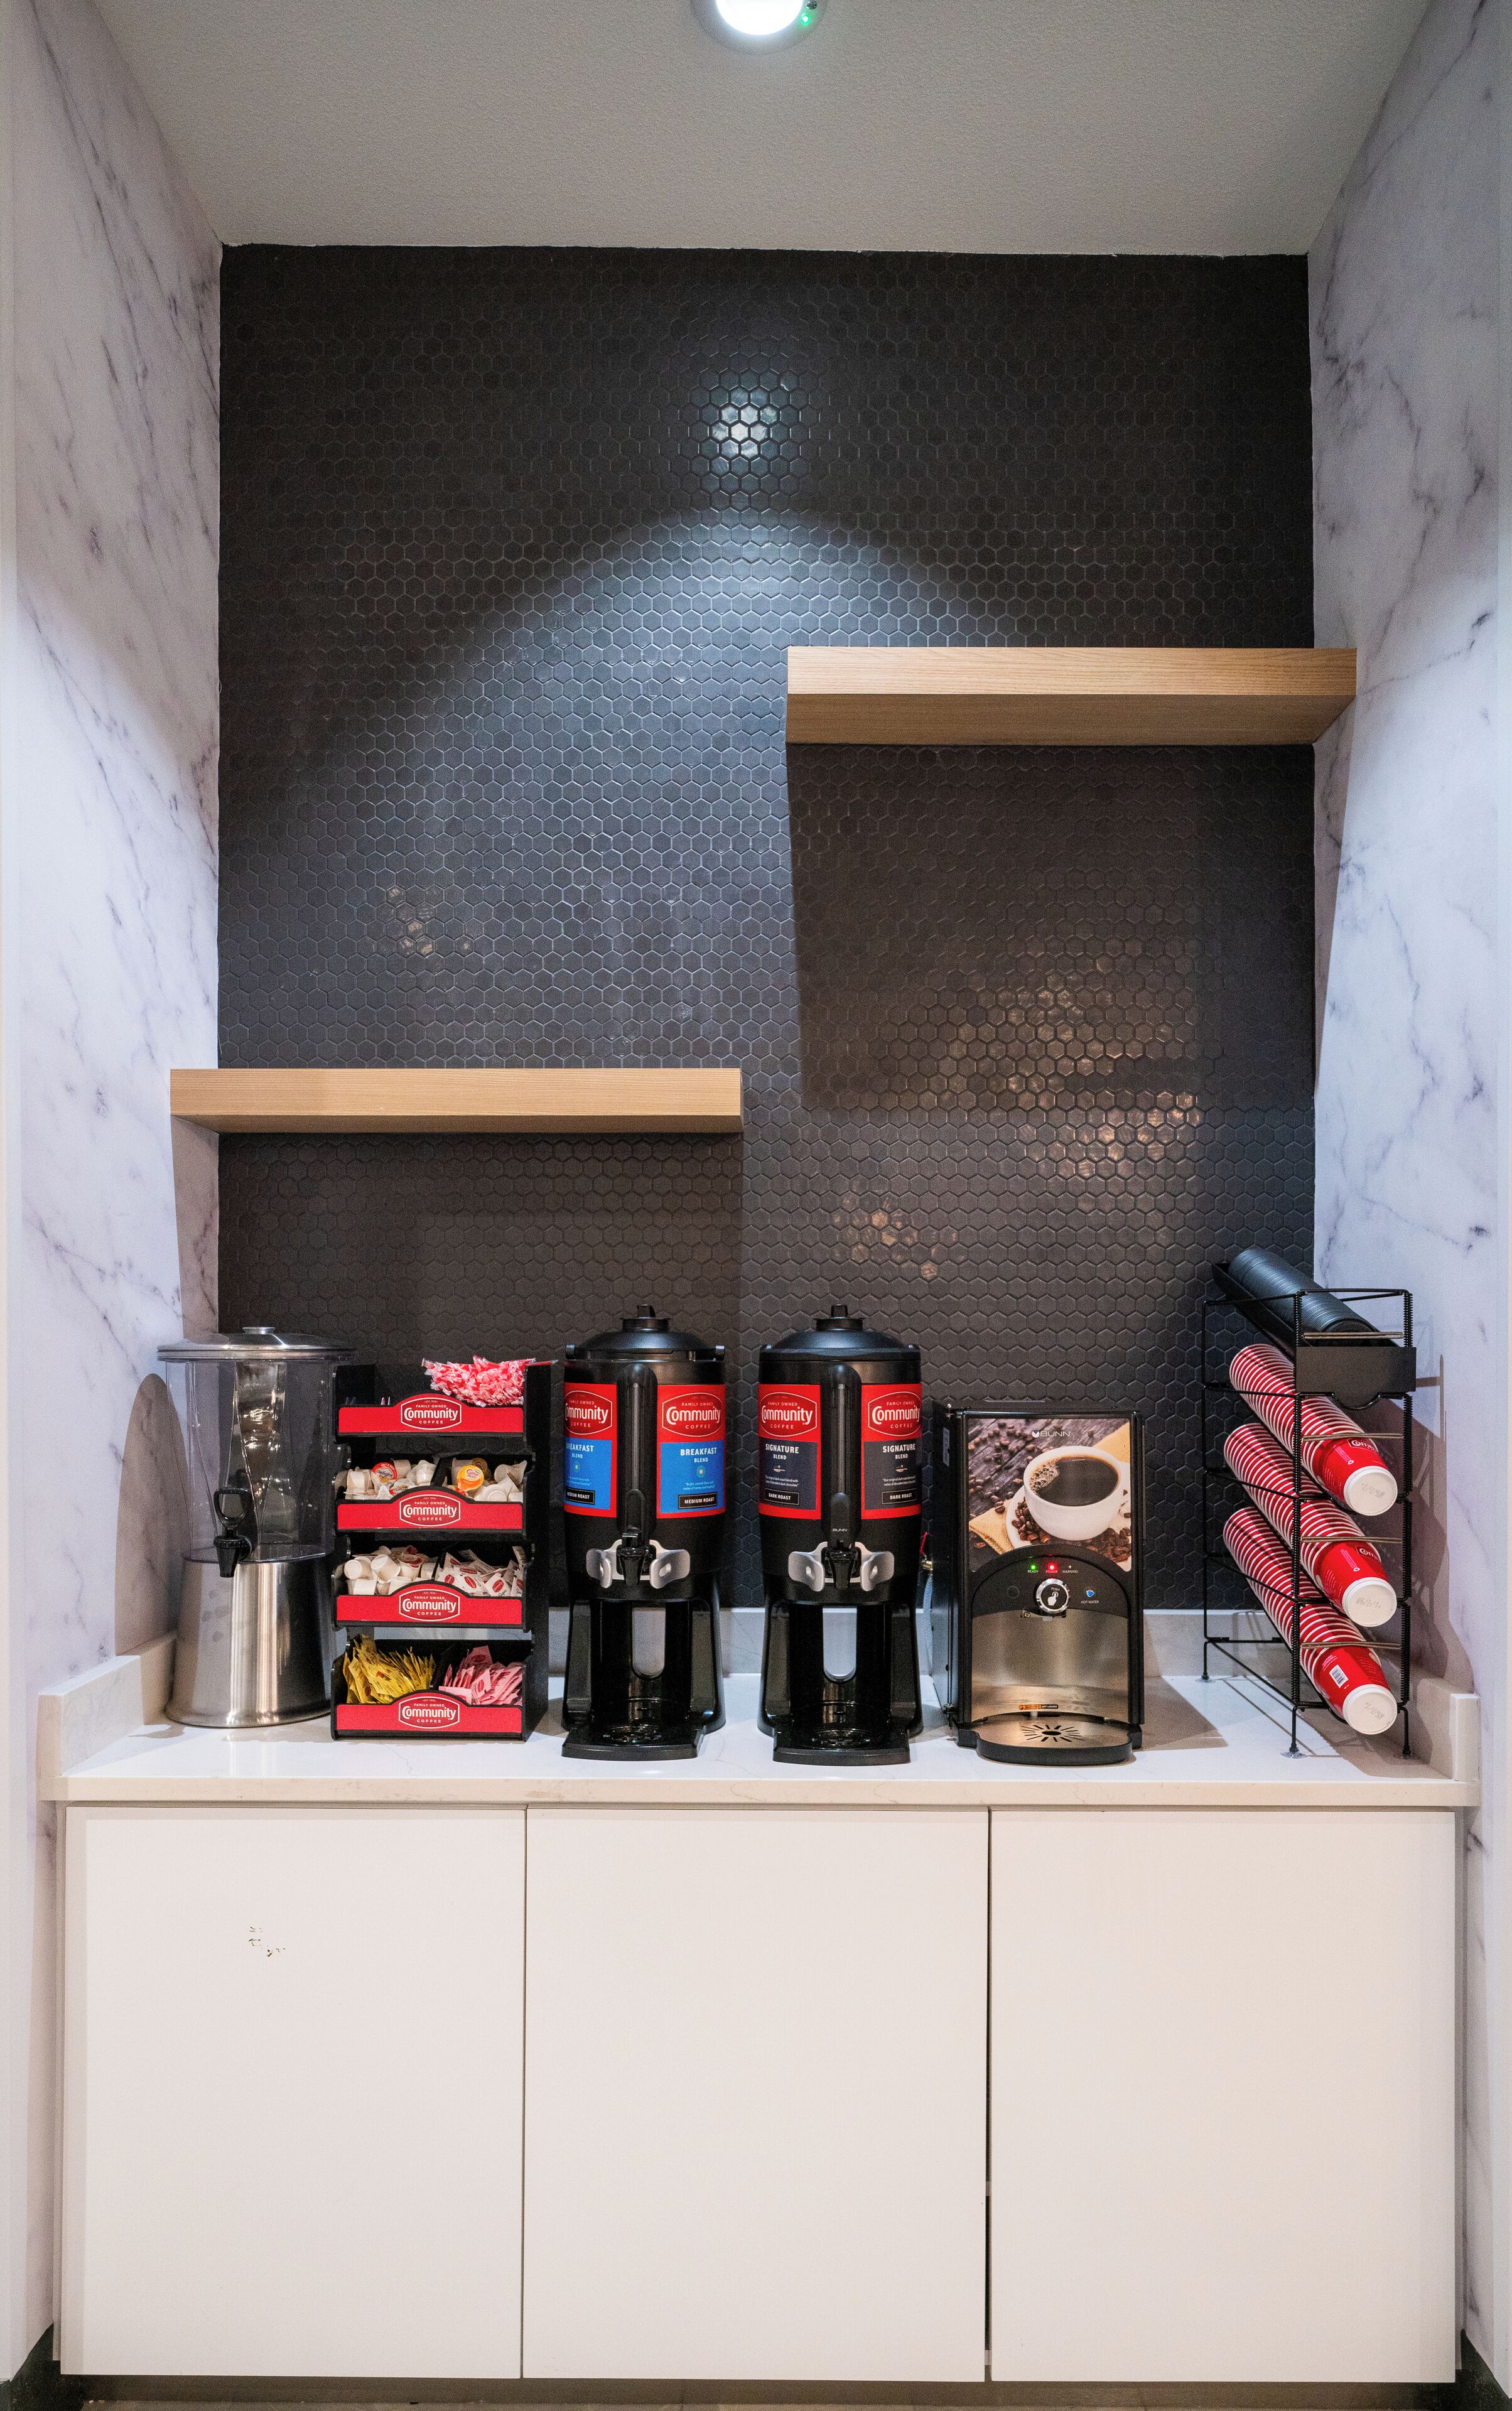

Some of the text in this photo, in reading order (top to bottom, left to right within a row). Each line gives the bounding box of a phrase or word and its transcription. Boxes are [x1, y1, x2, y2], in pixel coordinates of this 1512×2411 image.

[404, 1407, 458, 1421] Community
[666, 1406, 721, 1425] Community
[762, 1405, 813, 1425] Community
[872, 1405, 921, 1425] Community
[680, 1447, 717, 1456] BREAKFAST
[765, 1443, 799, 1454] SIGNATURE
[882, 1443, 915, 1453] SIGNATURE
[402, 1504, 457, 1518] Community
[402, 1599, 456, 1613] Community
[402, 1706, 456, 1720] Community
